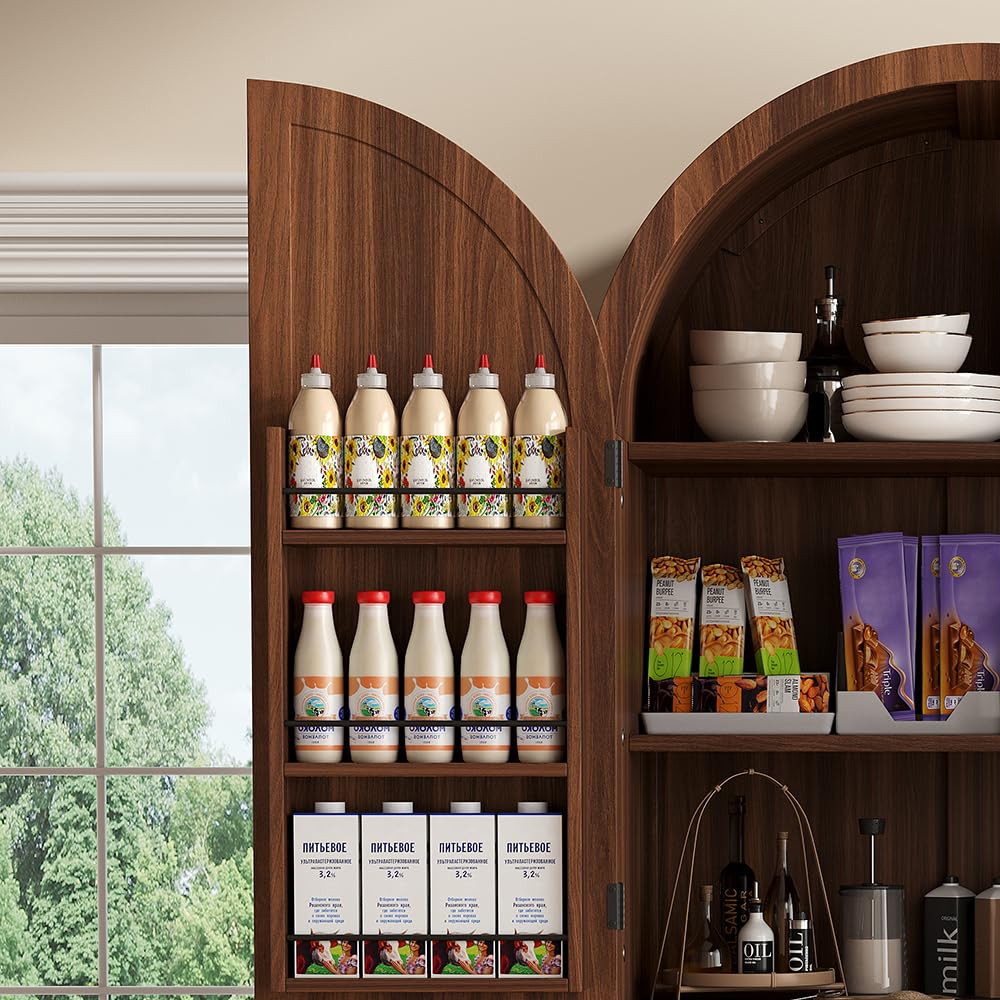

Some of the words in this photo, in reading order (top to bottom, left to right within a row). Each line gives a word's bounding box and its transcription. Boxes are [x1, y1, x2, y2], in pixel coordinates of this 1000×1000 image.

[656, 579, 674, 588] PEANUT
[753, 580, 771, 588] PEANUT
[706, 587, 725, 595] PEANUT
[882, 669, 892, 696] Triple
[303, 842, 347, 853] ПИТЬЕВОЕ
[371, 842, 415, 853] ПИТЬЕВОЕ
[440, 842, 483, 853] ПИТЬЕВОЕ
[507, 842, 551, 853] ПИТЬЕВОЕ
[319, 870, 336, 878] 3,2%
[387, 870, 404, 878] 3,2%
[456, 870, 472, 878] 3,2%
[523, 870, 540, 878] 3,2%
[744, 943, 771, 957] OIL
[789, 932, 804, 972] OIL
[937, 928, 958, 994] milk
